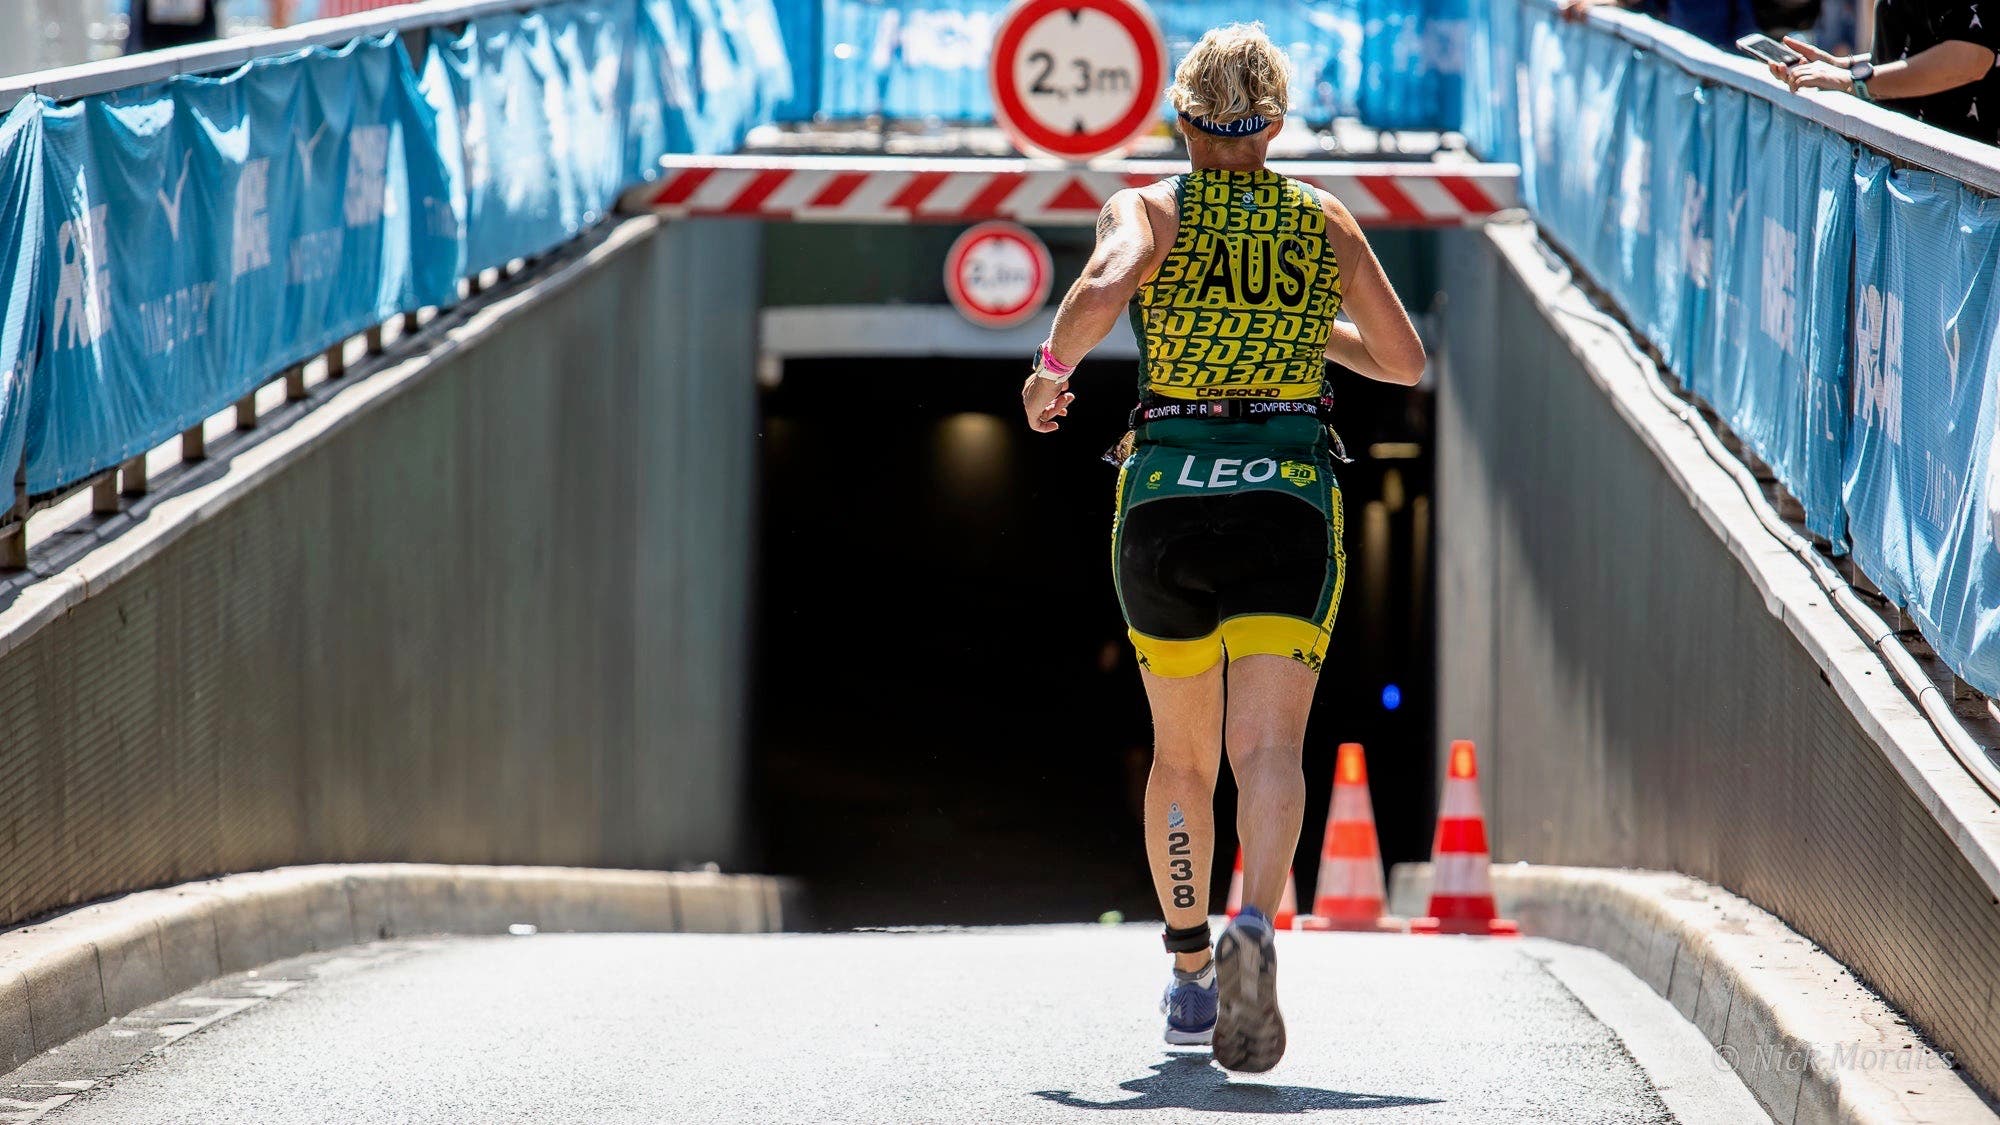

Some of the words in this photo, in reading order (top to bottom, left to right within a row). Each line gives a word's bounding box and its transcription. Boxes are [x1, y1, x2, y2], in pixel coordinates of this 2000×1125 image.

[1238, 115, 1265, 132] 2019
[1197, 237, 1307, 307] AUS
[1225, 388, 1280, 398] SQUAD
[1177, 455, 1277, 488] LEO
[1168, 831, 1196, 909] 238
